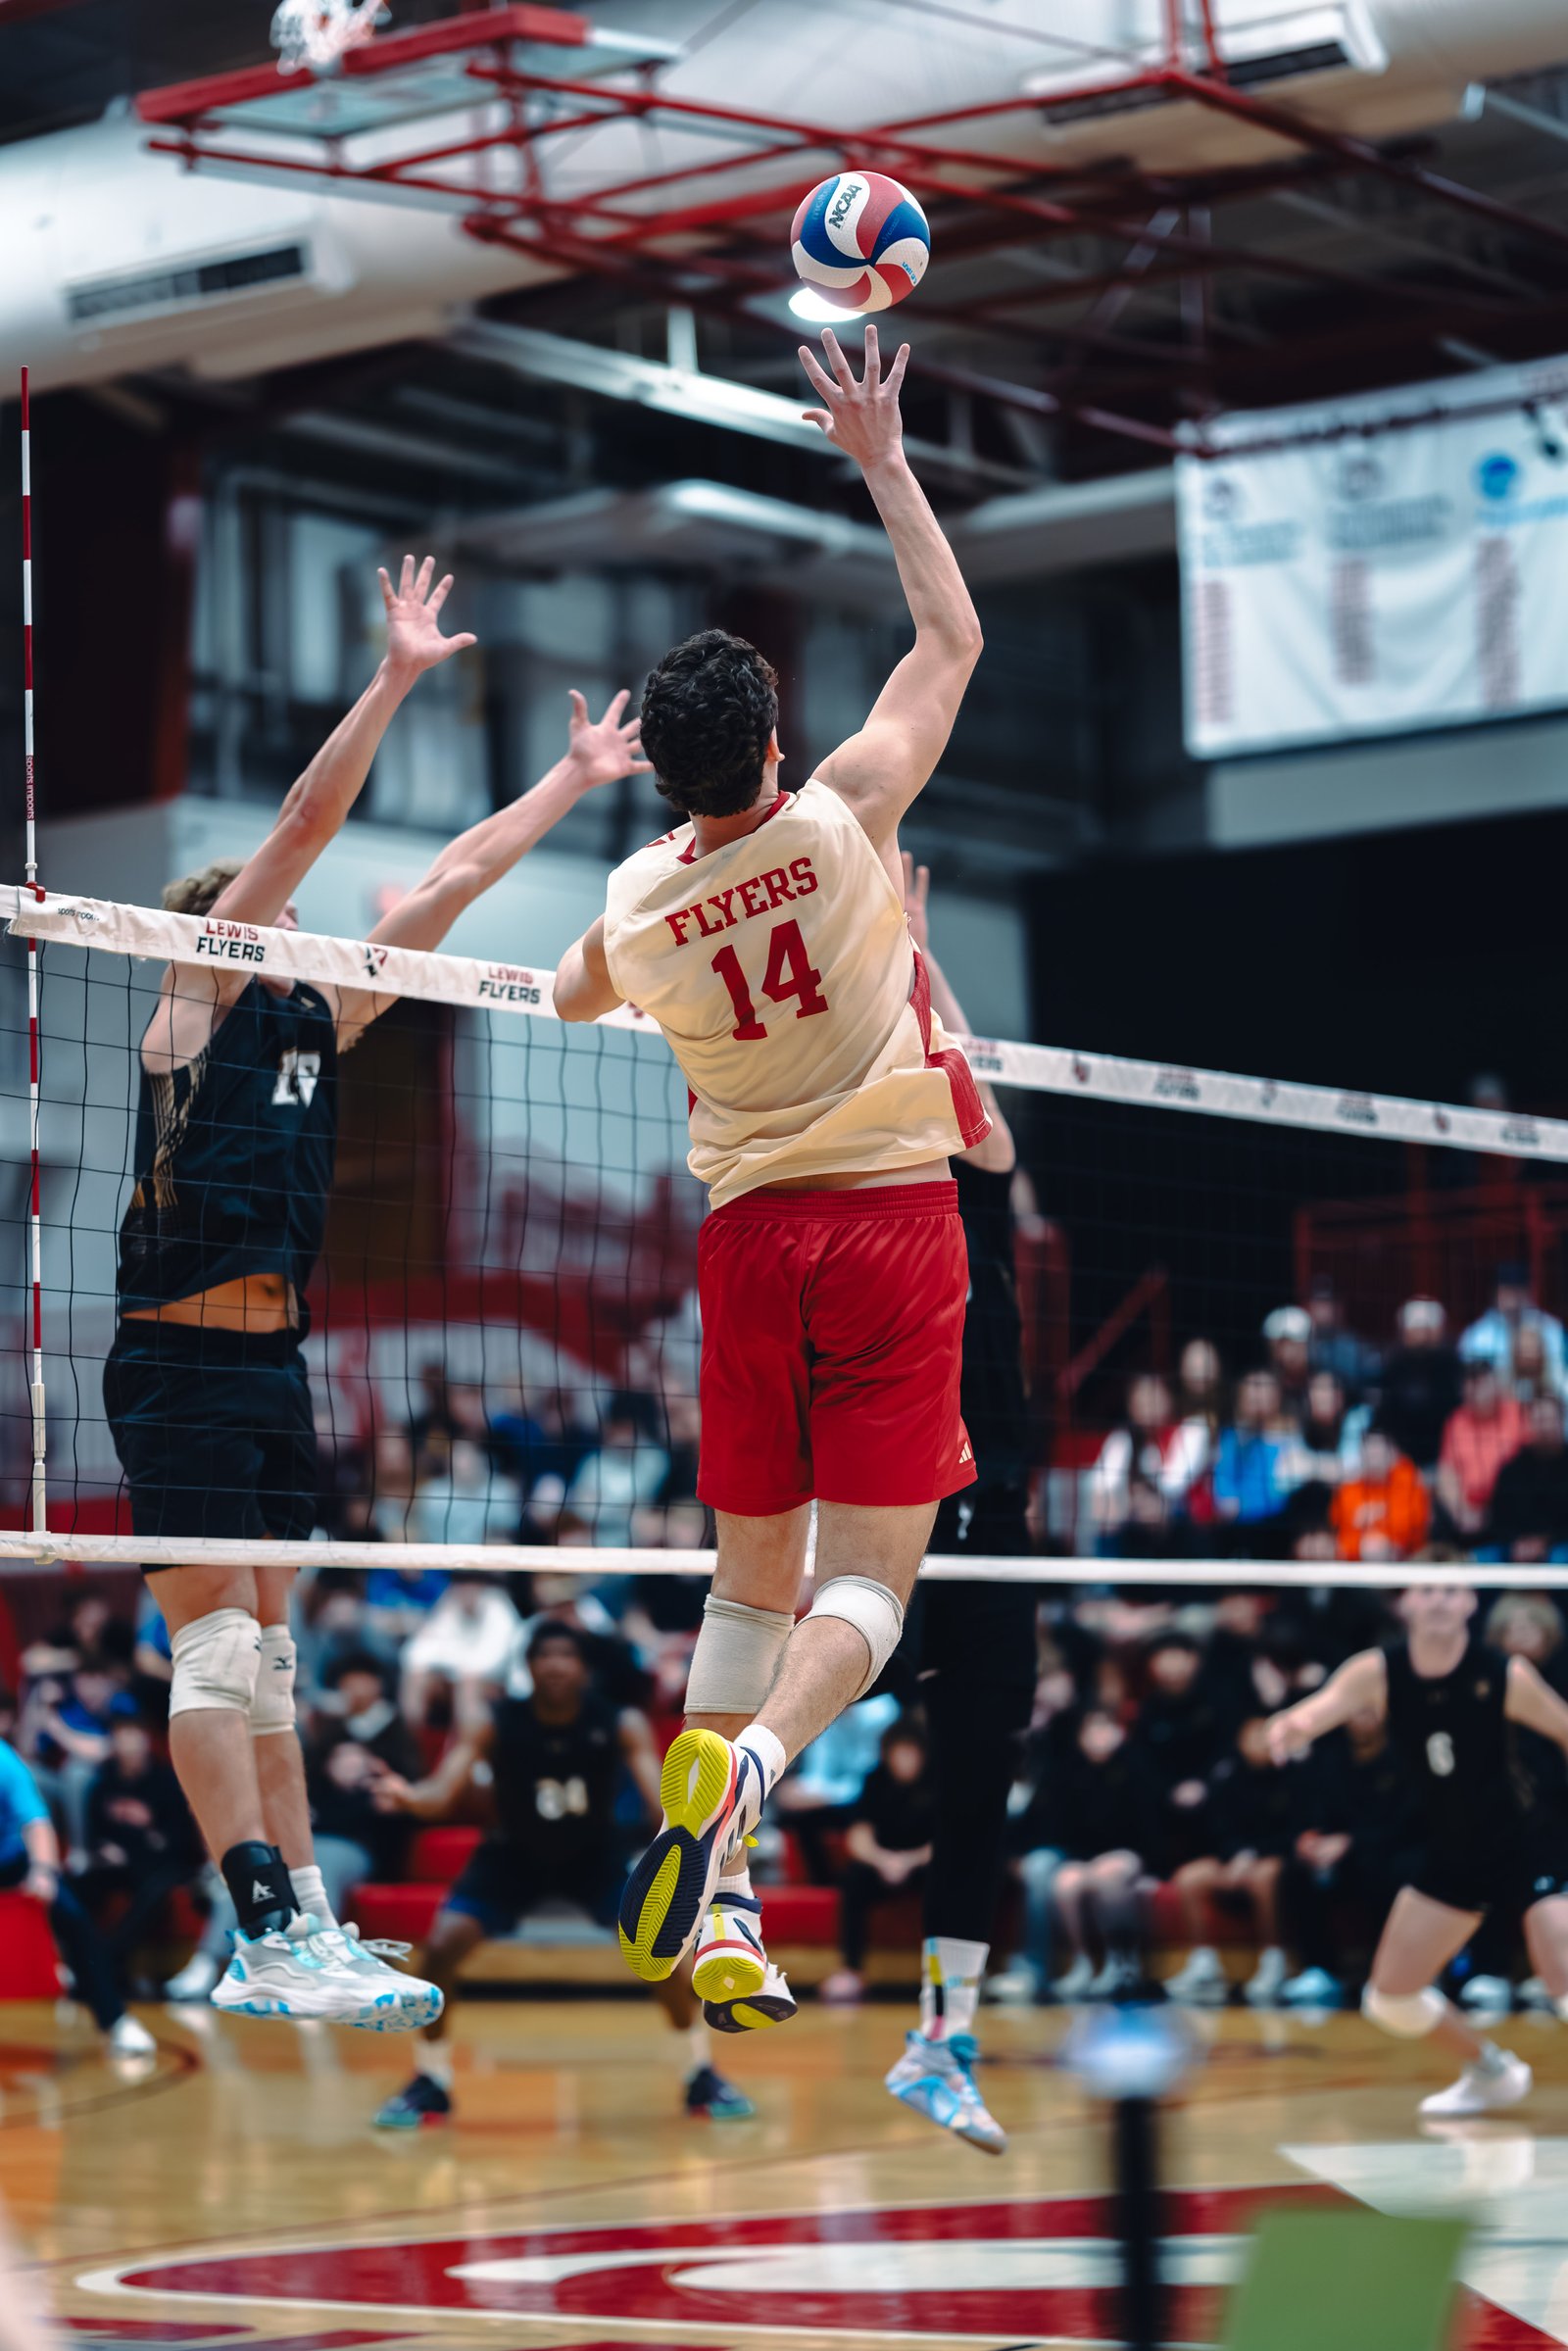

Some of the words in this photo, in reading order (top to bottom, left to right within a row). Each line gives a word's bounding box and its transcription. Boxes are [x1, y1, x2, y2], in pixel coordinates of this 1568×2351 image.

[828, 184, 862, 229] NCAA
[25, 756, 34, 784] sports
[25, 785, 35, 819] imports
[664, 857, 819, 947] FLYERS
[206, 920, 259, 941] LEWIS
[196, 936, 266, 962] FLYERS
[478, 980, 541, 1004] FLYERS
[710, 918, 829, 1041] 14
